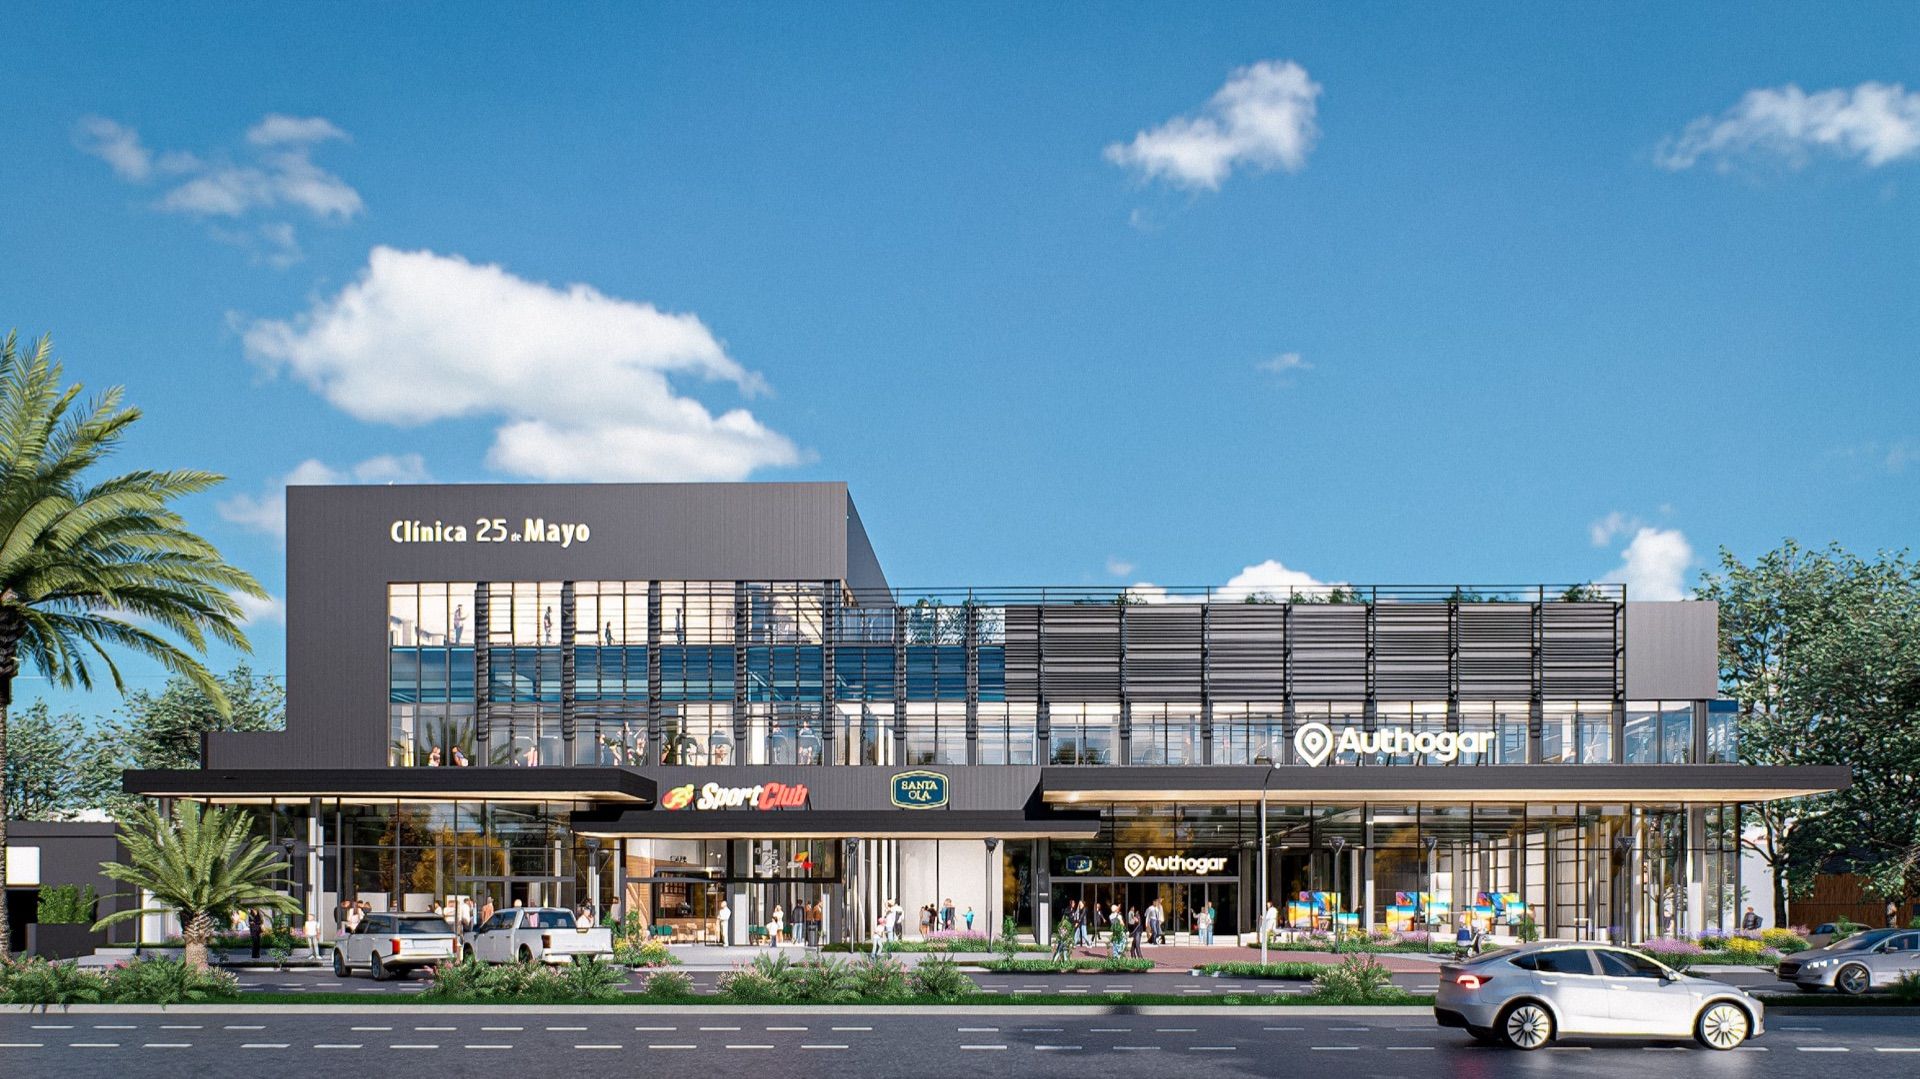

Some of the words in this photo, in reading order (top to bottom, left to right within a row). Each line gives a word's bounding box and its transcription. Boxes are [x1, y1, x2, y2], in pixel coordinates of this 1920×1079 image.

[390, 519, 467, 543] Clínica
[475, 518, 508, 542] 25
[524, 518, 591, 549] Mayo
[1336, 727, 1496, 762] Authogar
[901, 780, 938, 790] SANTA
[908, 790, 932, 802] OLA
[1145, 854, 1228, 875] Authogar
